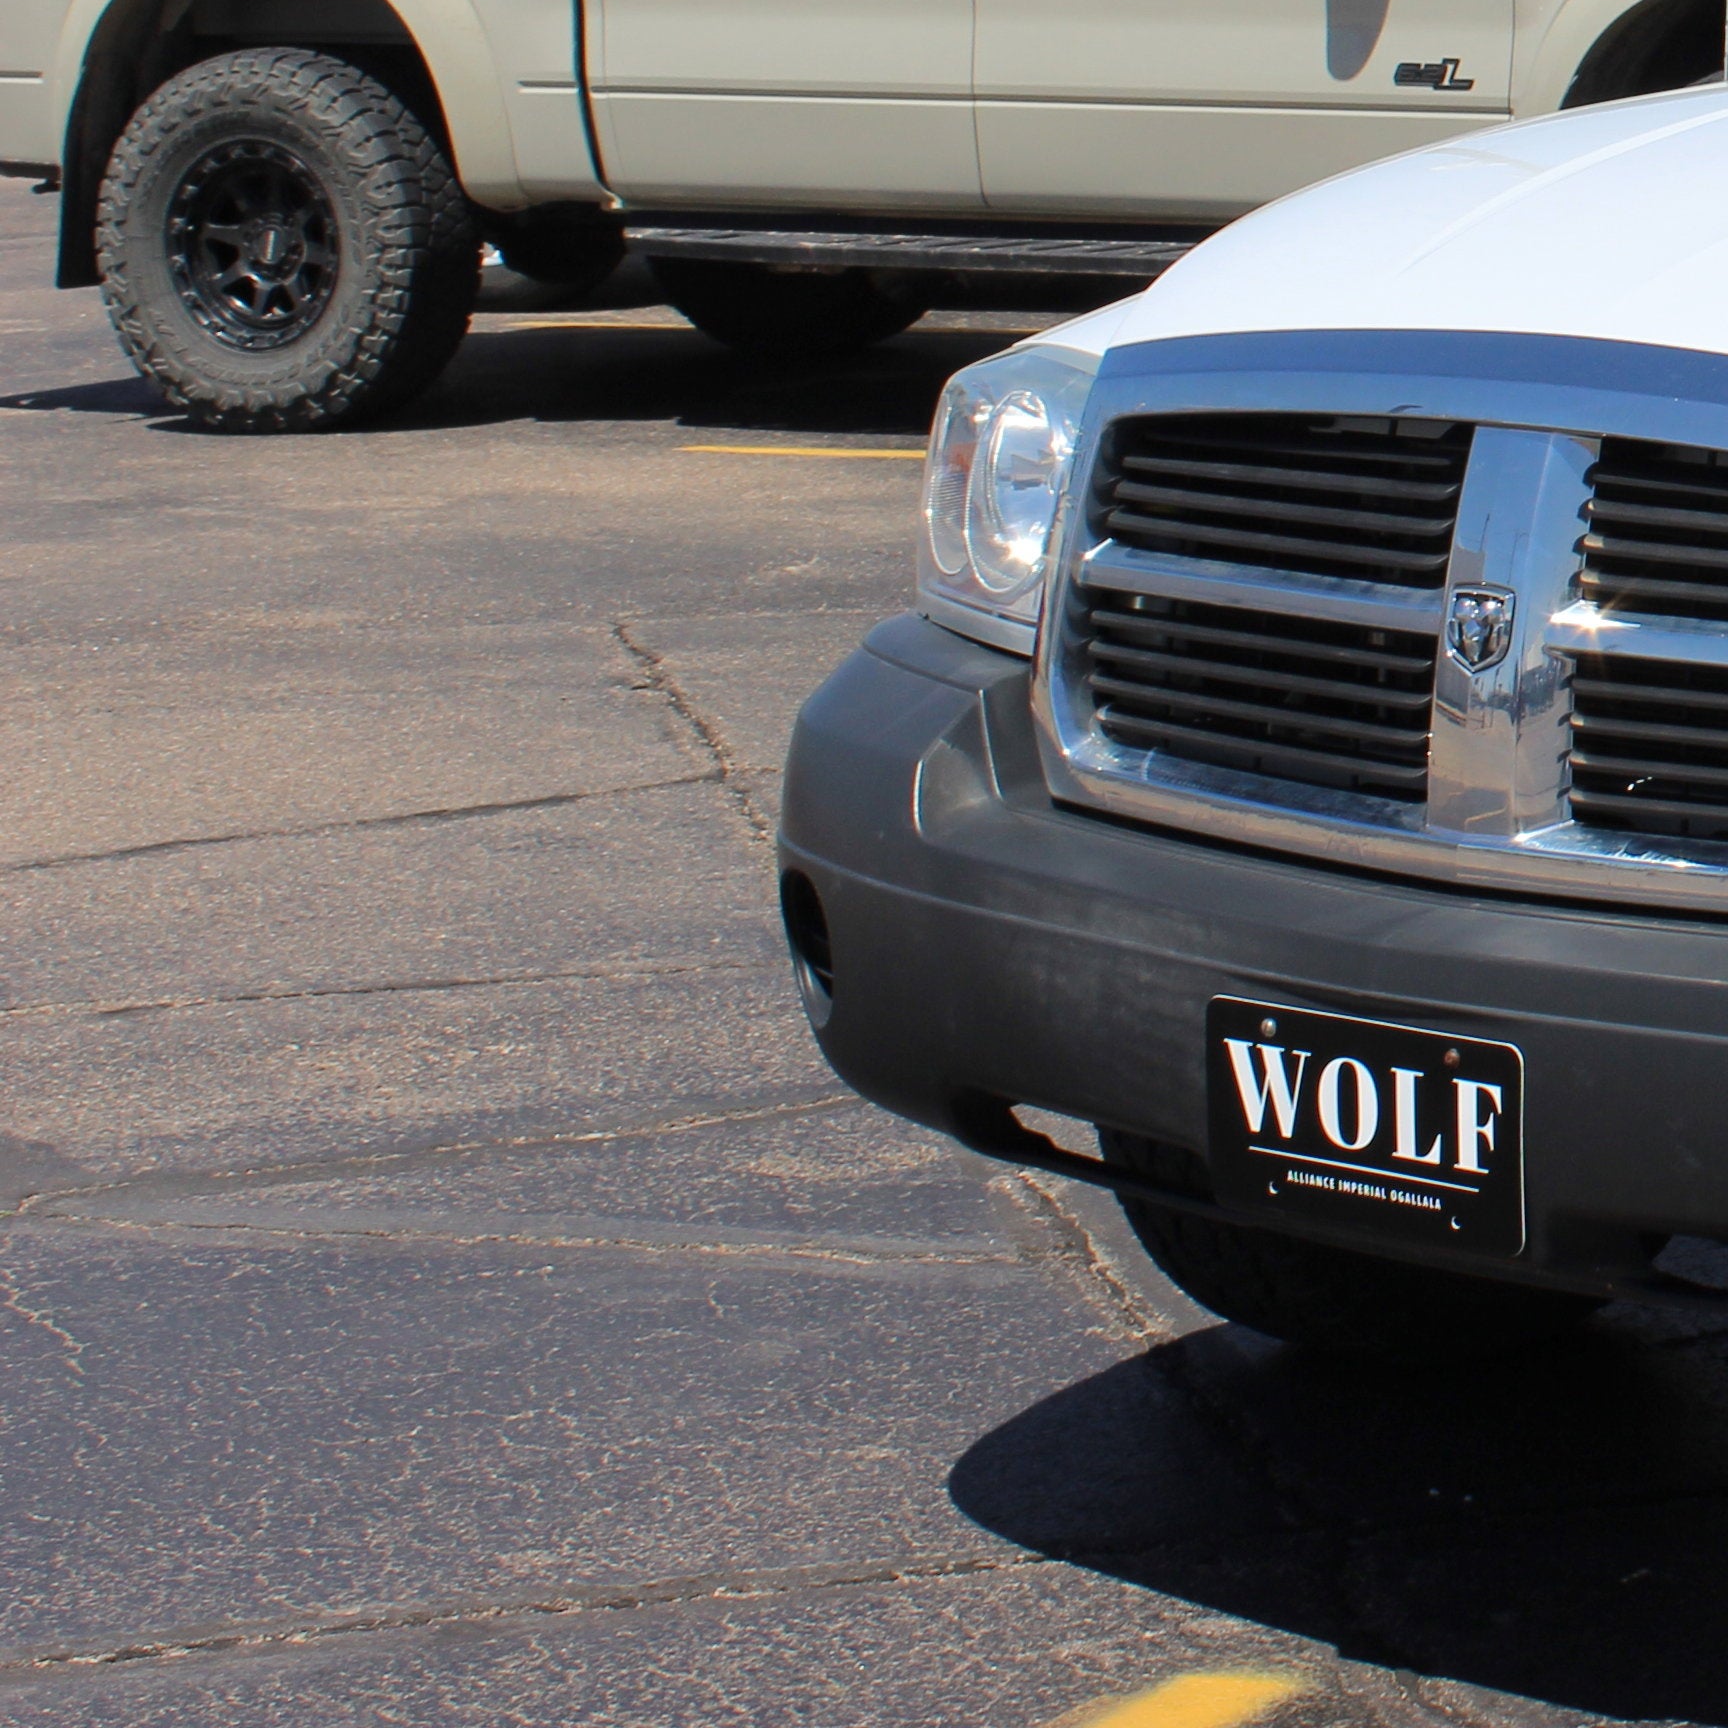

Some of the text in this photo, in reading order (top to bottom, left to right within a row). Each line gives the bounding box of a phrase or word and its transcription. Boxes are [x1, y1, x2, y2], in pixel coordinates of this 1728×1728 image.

[1223, 1038, 1502, 1174] WOLF
[1286, 1170, 1442, 1211] ALLIANCE IMPERIAL OGALLALA
